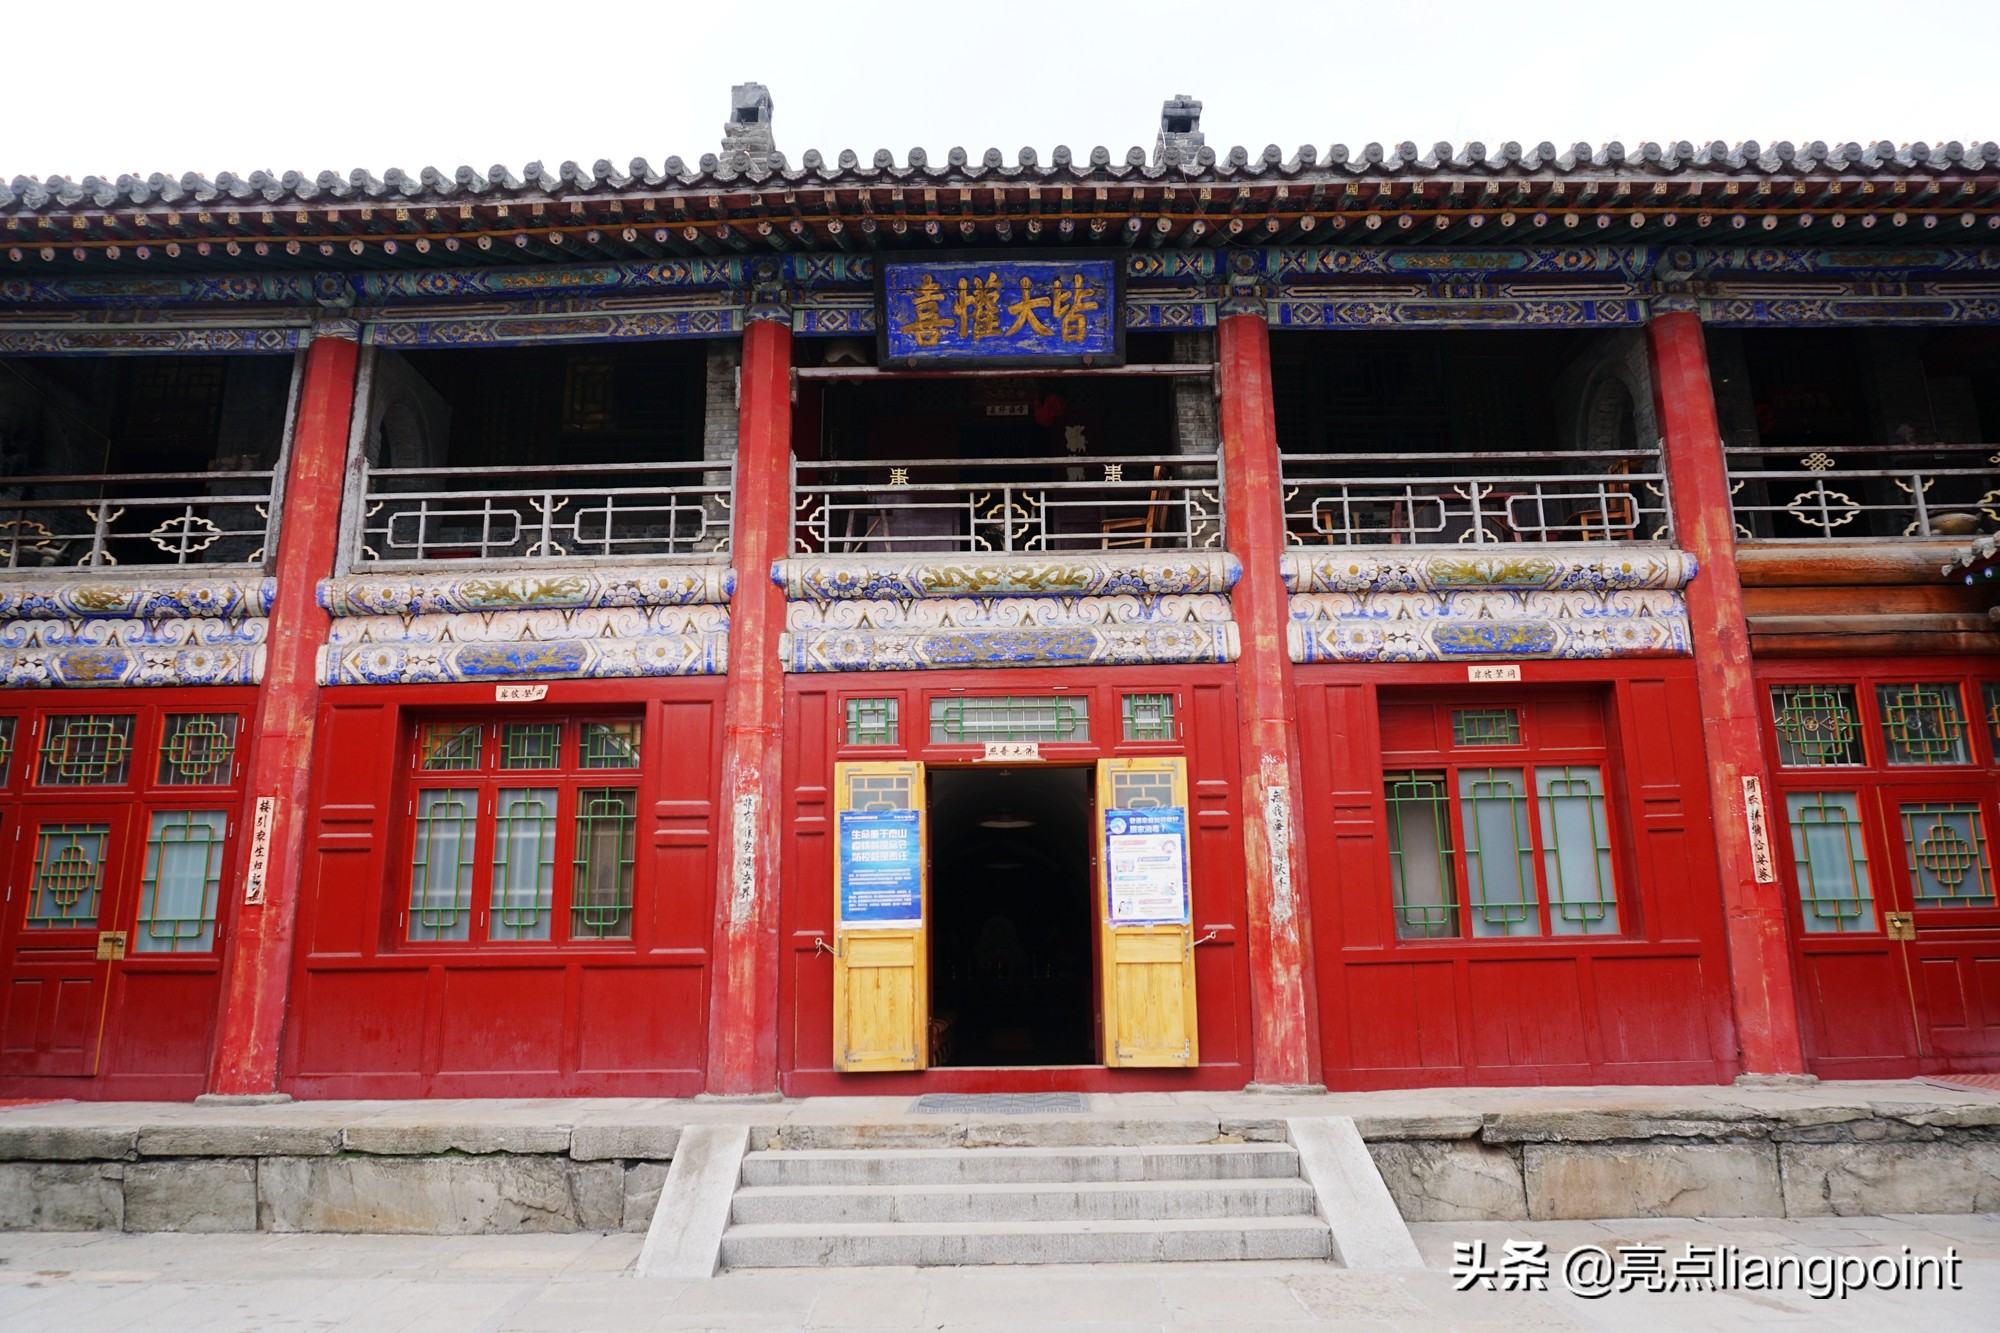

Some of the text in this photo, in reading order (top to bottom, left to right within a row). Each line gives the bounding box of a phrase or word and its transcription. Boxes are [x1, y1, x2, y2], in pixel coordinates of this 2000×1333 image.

[851, 828, 908, 840] 生命重于泰山
